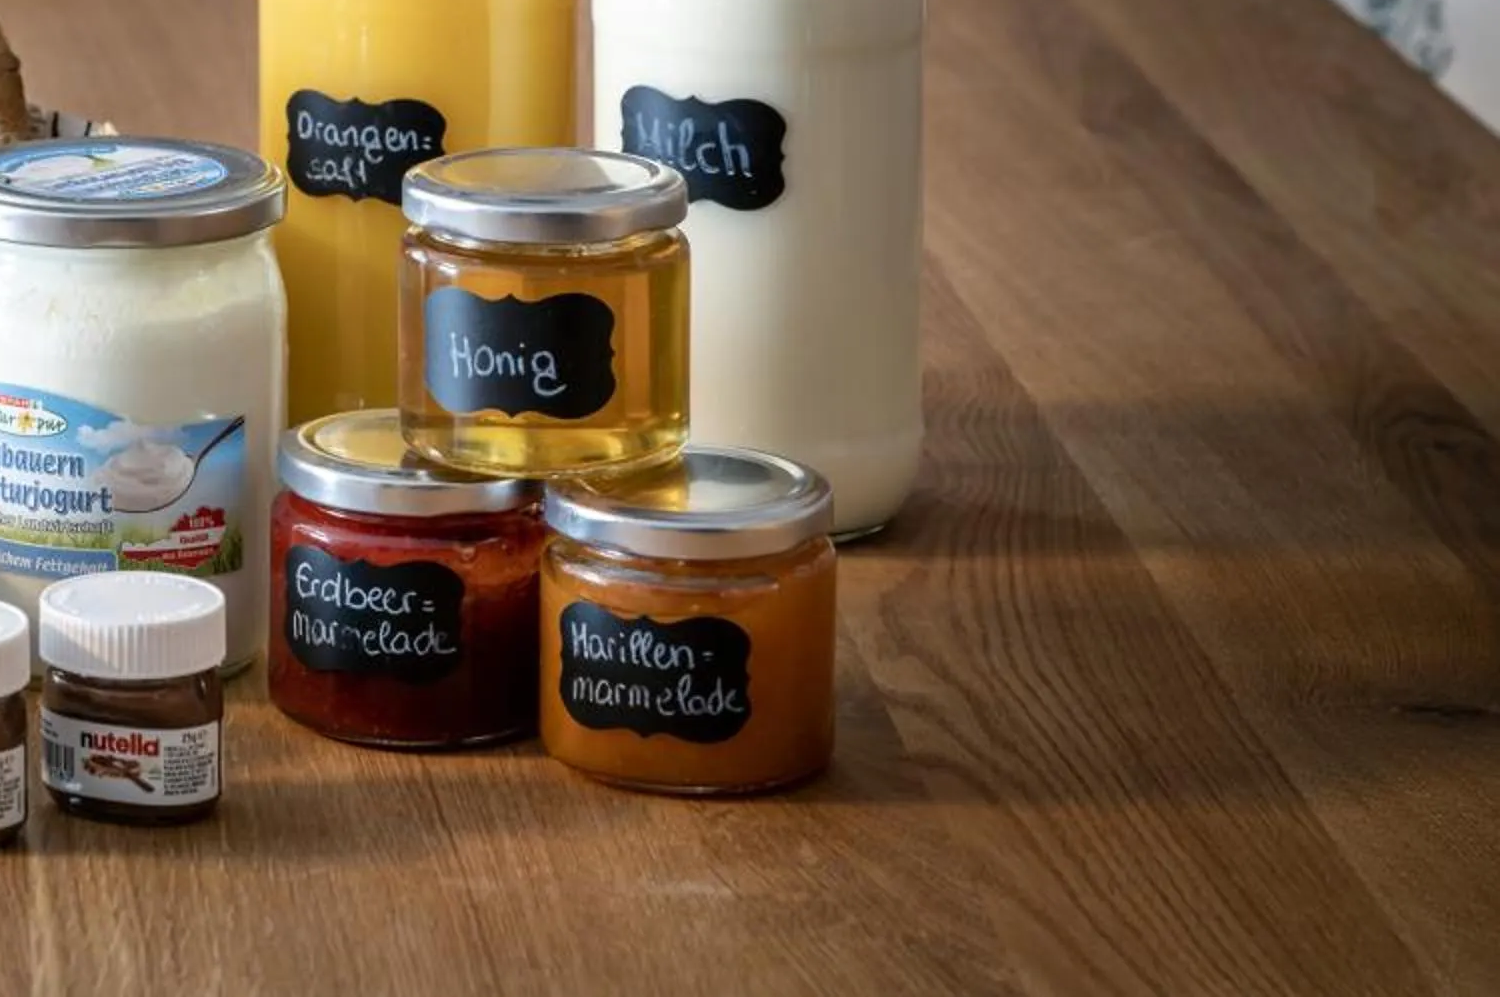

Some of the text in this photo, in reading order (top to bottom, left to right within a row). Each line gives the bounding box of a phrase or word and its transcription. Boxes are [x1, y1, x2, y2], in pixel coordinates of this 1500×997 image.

[635, 111, 753, 178] Milch
[449, 331, 568, 397] Honig
[80, 730, 160, 757] nutella
